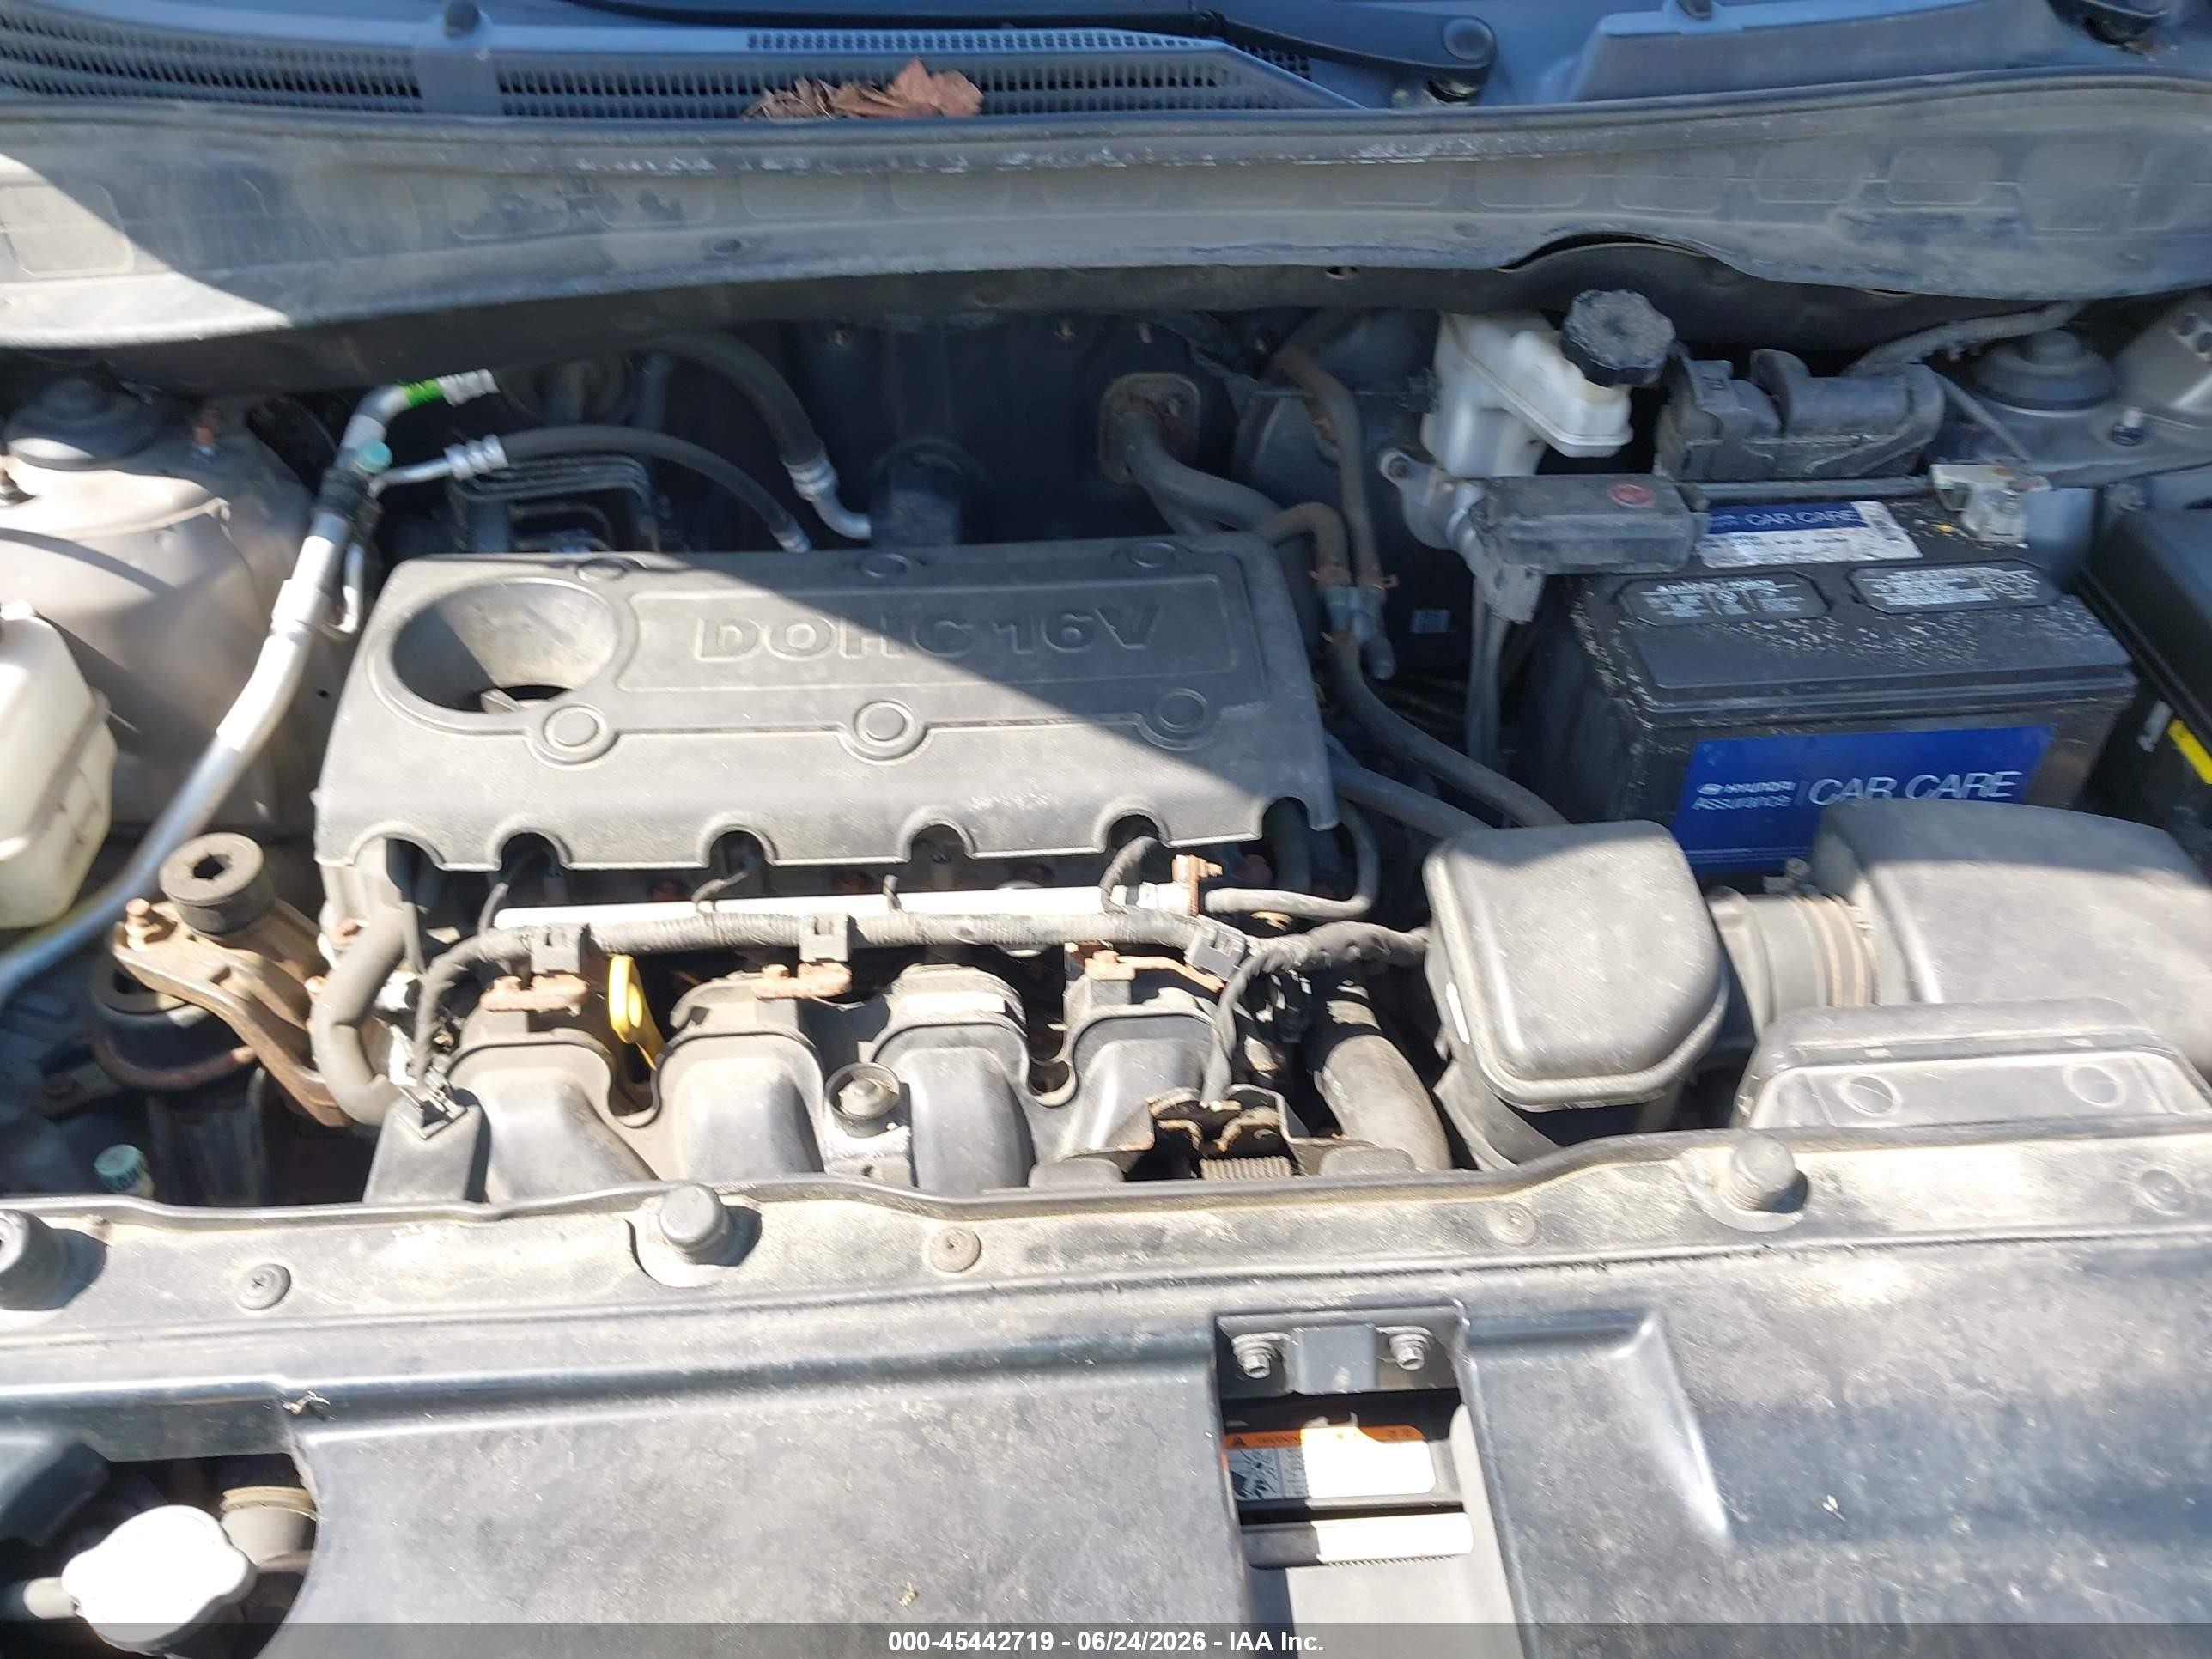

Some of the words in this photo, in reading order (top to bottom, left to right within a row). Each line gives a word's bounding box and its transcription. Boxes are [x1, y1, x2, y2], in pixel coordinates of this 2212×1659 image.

[1744, 513, 1796, 526] CAR
[1797, 509, 1863, 523] CARE
[694, 611, 973, 663] DOHC
[994, 603, 1164, 655] 16V
[1808, 776, 1898, 806] CAR
[1904, 770, 2023, 799] CARE
